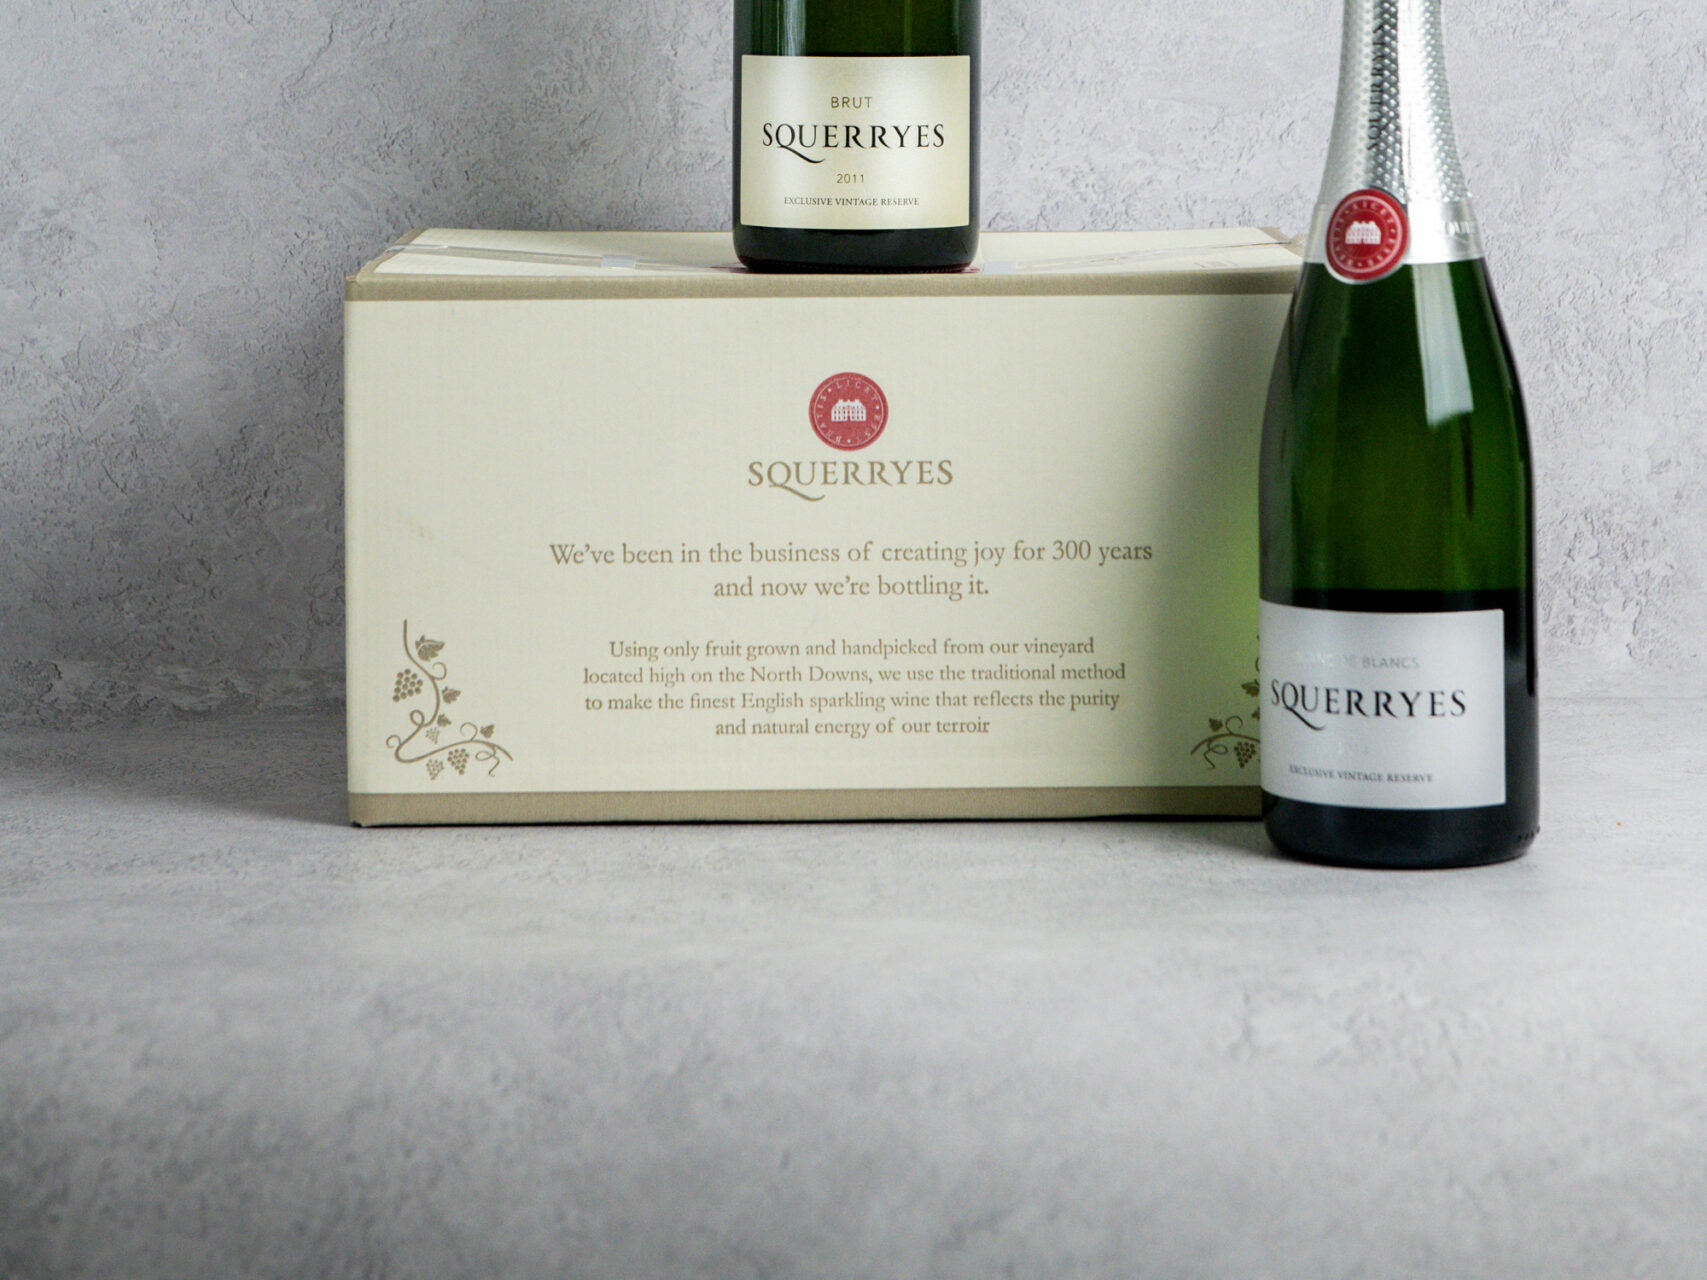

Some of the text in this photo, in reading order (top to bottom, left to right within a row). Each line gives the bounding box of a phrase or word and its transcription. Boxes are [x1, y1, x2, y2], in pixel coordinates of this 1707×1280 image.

[830, 95, 873, 110] BRUT
[762, 122, 945, 165] SQUERRYES
[836, 172, 865, 185] 2011
[784, 196, 920, 207] EXCLUSIVE VINTAGE RESERVE
[747, 459, 954, 502] SQUERRYES
[548, 539, 1153, 568] We've been in the business of creating joy for 300 years
[713, 573, 990, 601] and now we're bottling it.
[608, 636, 1095, 662] Using only fruit grown and handpicked from our vineyard
[583, 662, 1126, 688] located high on the North Downs, we use the traditional method
[584, 689, 1121, 713] to make the finest English sparkling wine that reflects the purity
[1270, 678, 1467, 731] SQUERRYES
[715, 716, 991, 740] and natural energy of our terroir
[1288, 763, 1434, 783] EXCLUSIVE VINTAGE RESERVE
